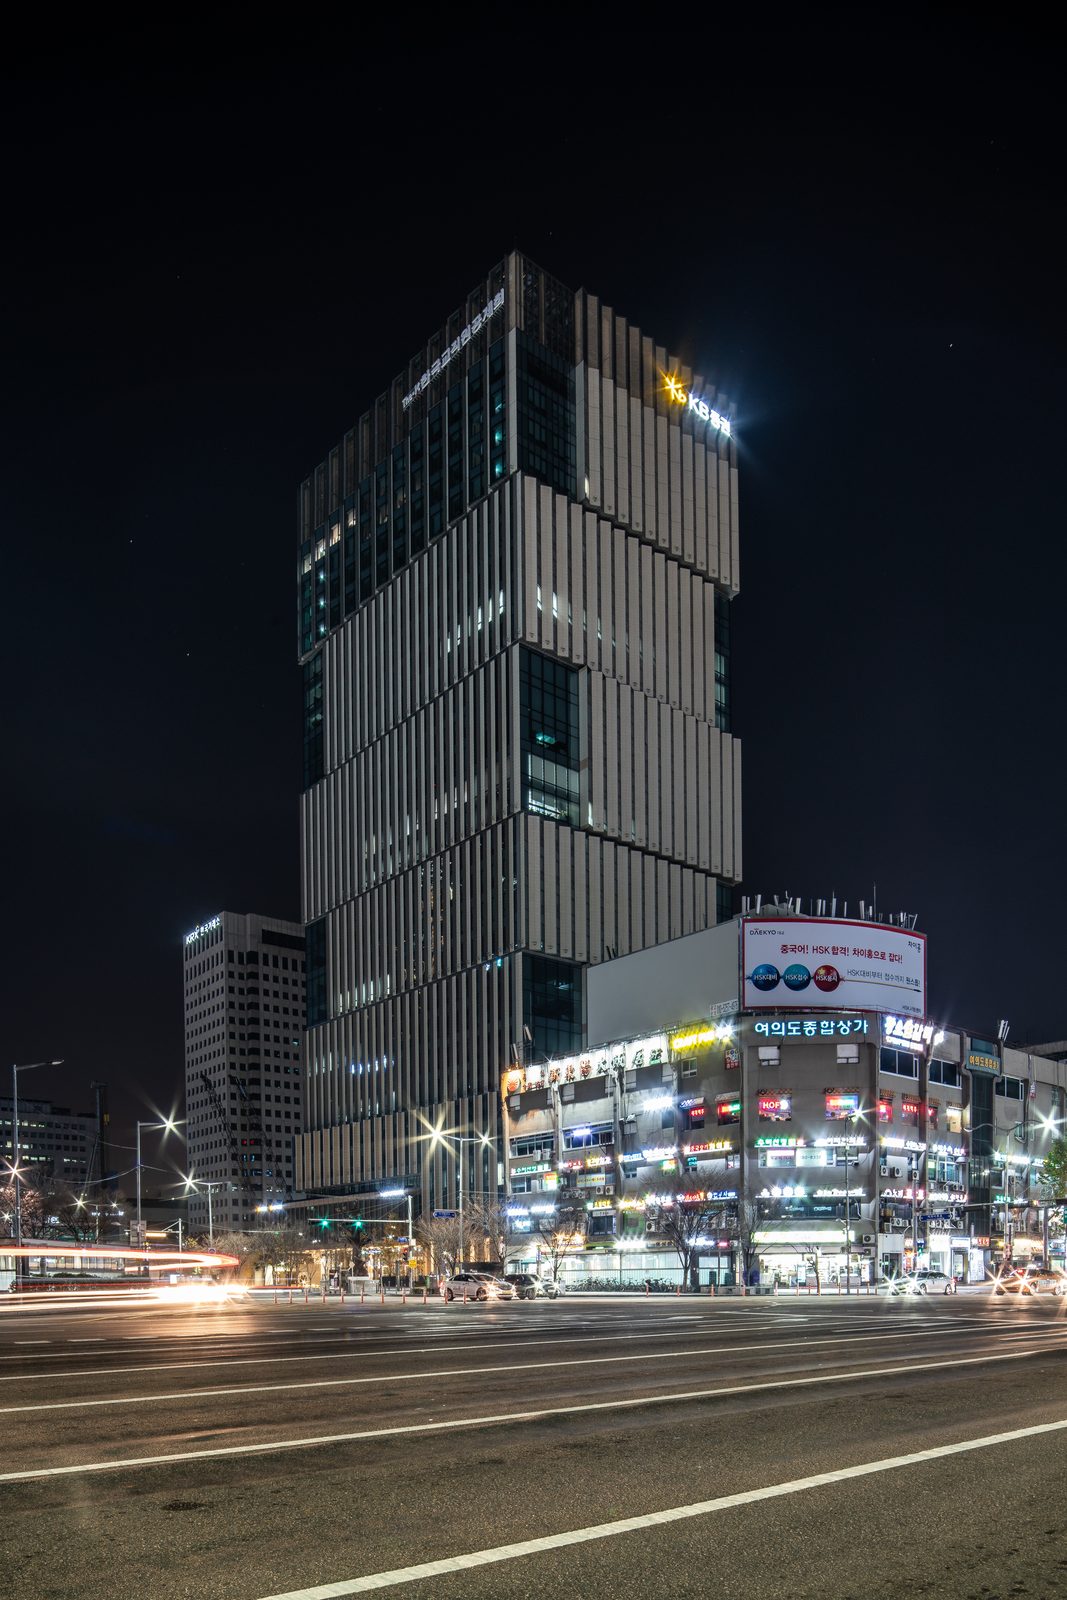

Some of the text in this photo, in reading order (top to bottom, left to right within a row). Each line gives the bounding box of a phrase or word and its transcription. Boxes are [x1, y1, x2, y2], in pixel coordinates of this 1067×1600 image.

[780, 945, 902, 964] 중국어! HSK 합격! 차이홍으로 잡다!
[754, 1019, 869, 1037] 여의도종합상가
[763, 1101, 780, 1109] HOF
